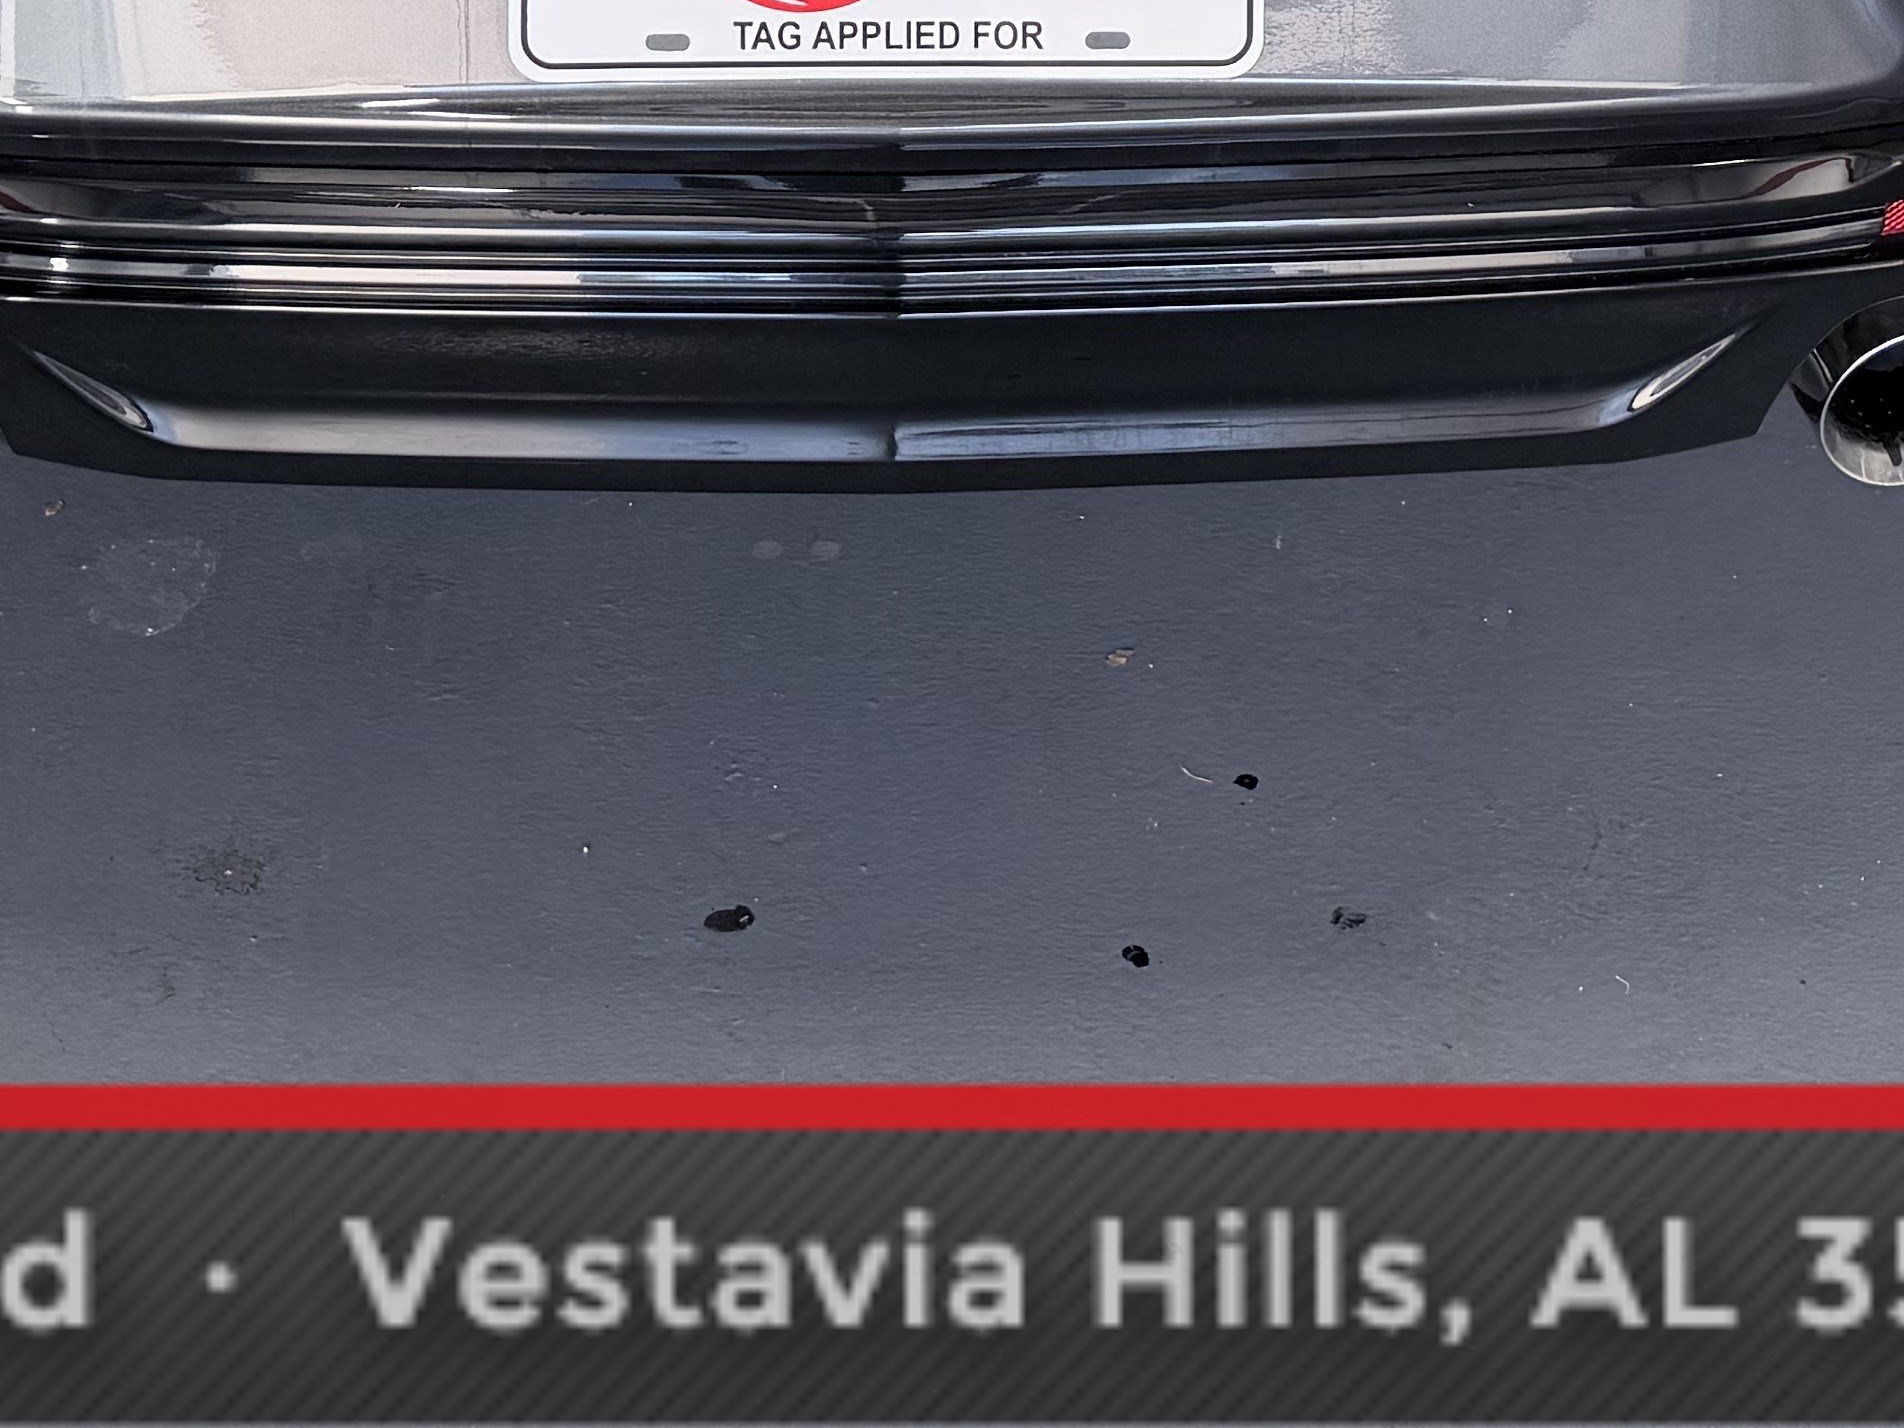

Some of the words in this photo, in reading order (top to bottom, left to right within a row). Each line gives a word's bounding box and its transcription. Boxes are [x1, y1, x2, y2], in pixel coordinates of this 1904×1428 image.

[733, 20, 801, 50] TAG
[812, 20, 960, 50] APPLIED
[973, 20, 1044, 50] FOR
